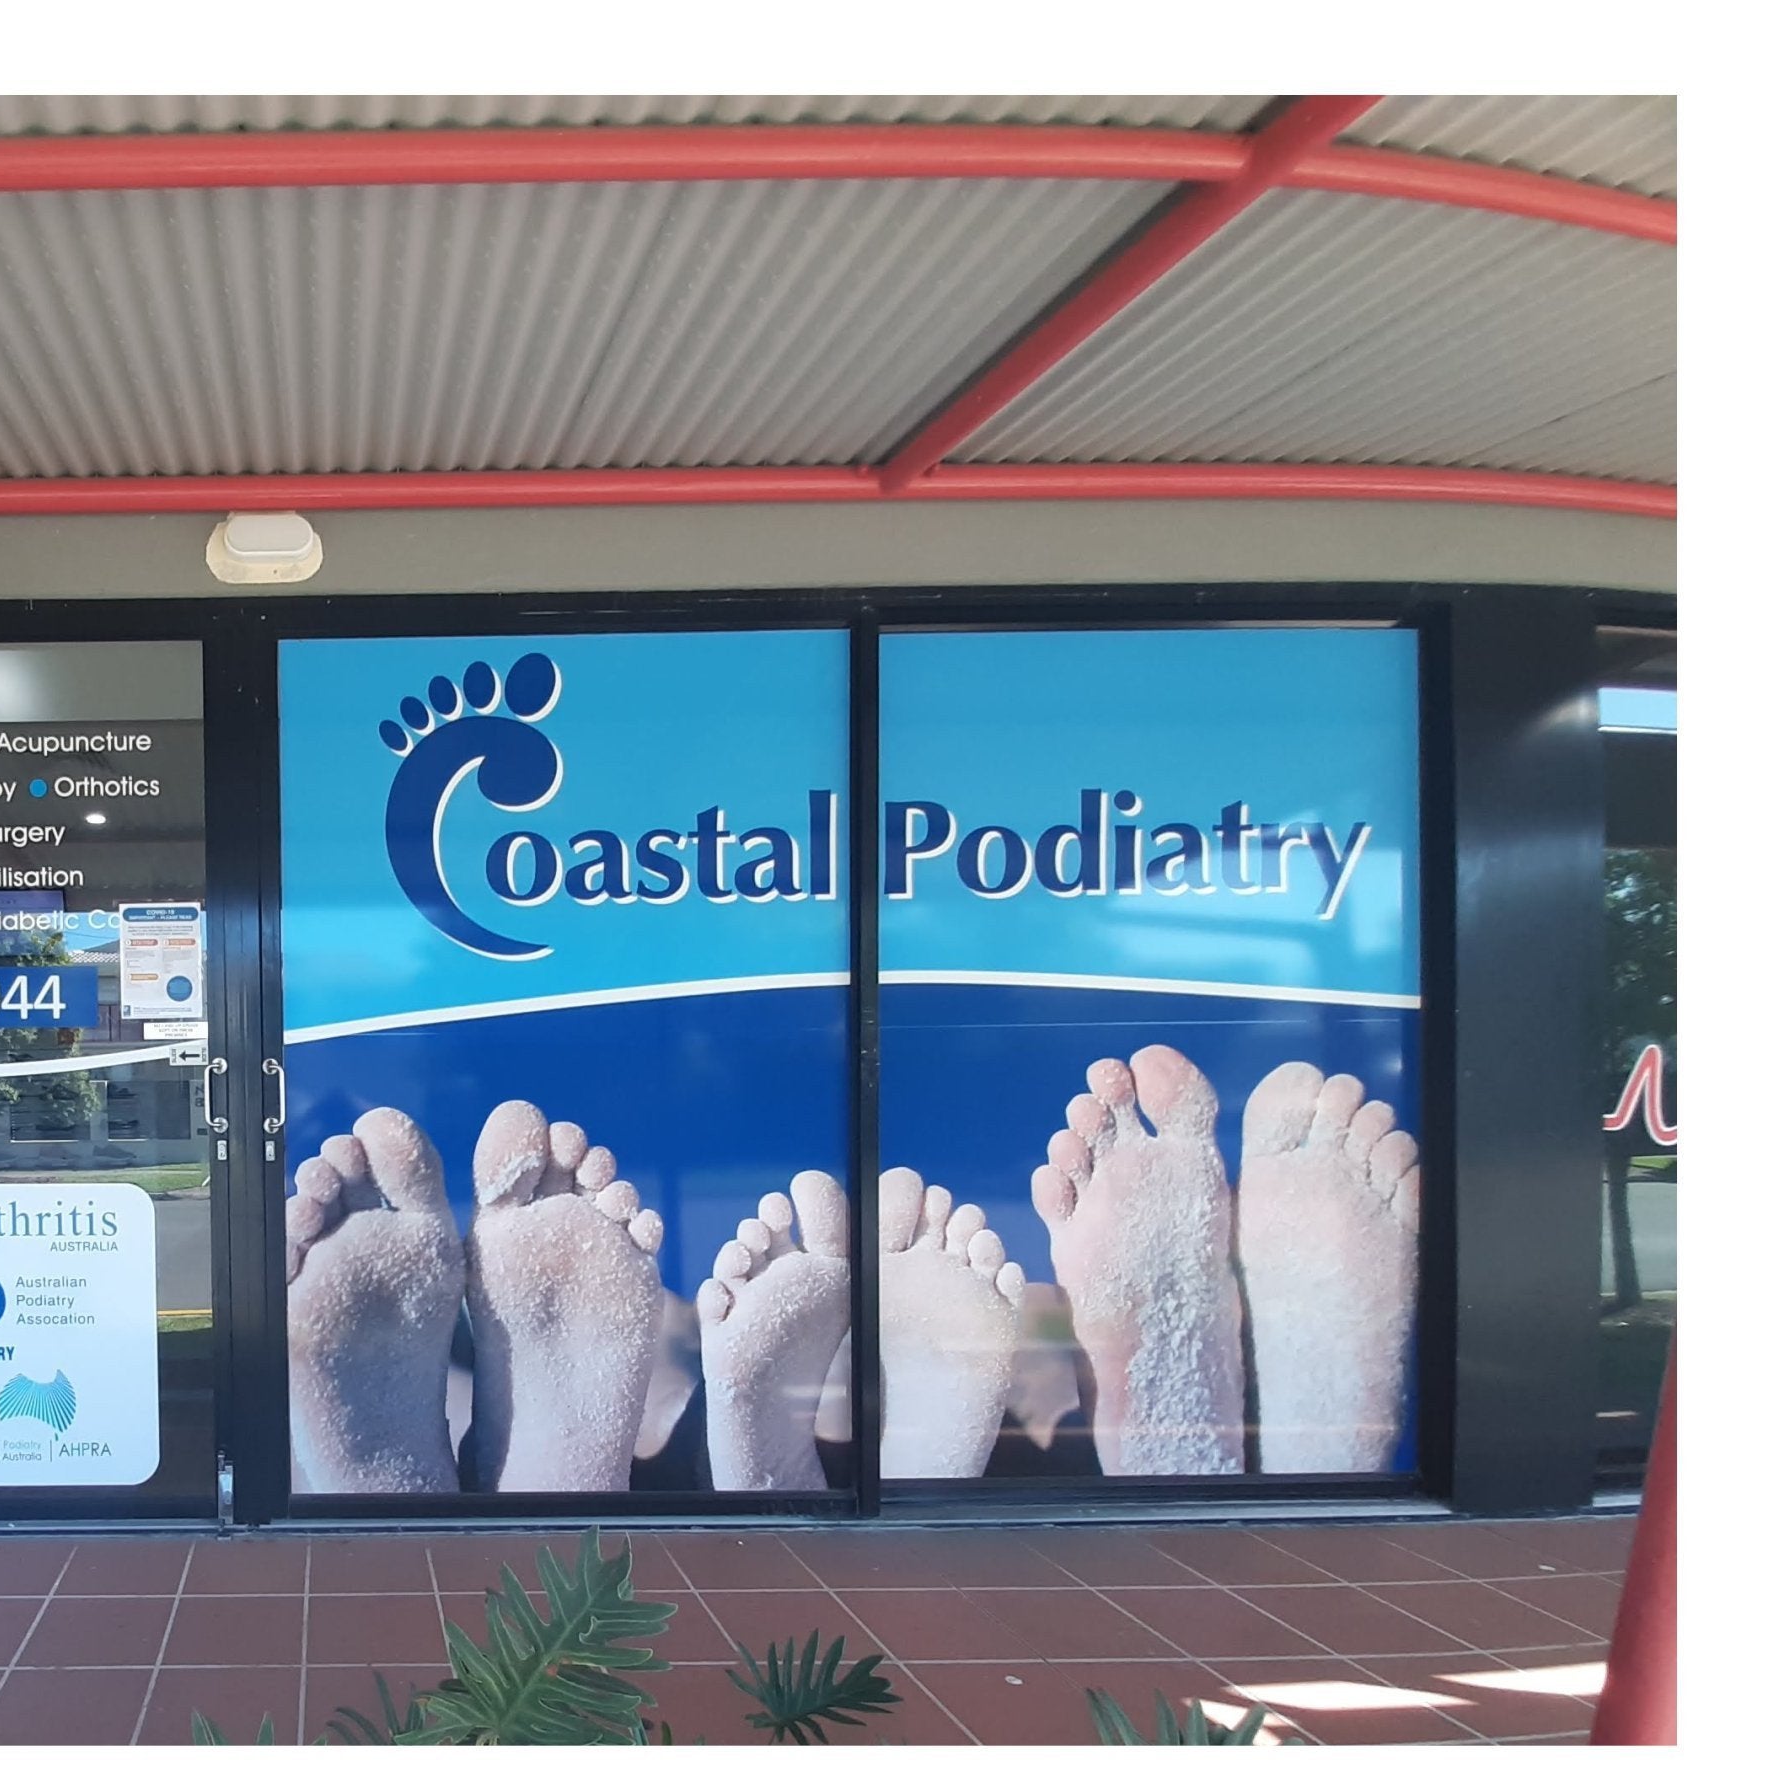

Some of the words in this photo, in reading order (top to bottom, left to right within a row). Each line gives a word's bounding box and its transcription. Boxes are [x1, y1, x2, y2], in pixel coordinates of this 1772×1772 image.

[54, 777, 160, 798] Orthotics
[383, 714, 838, 961] Coastal
[881, 789, 1367, 921] Podiatry
[50, 1242, 118, 1252] AUSTRALIA
[16, 1276, 87, 1288] Australian
[16, 1295, 75, 1309] Podiatry
[16, 1313, 95, 1325] Assocation
[59, 1442, 111, 1457] AHPRA
[3, 1452, 42, 1461] Australia
